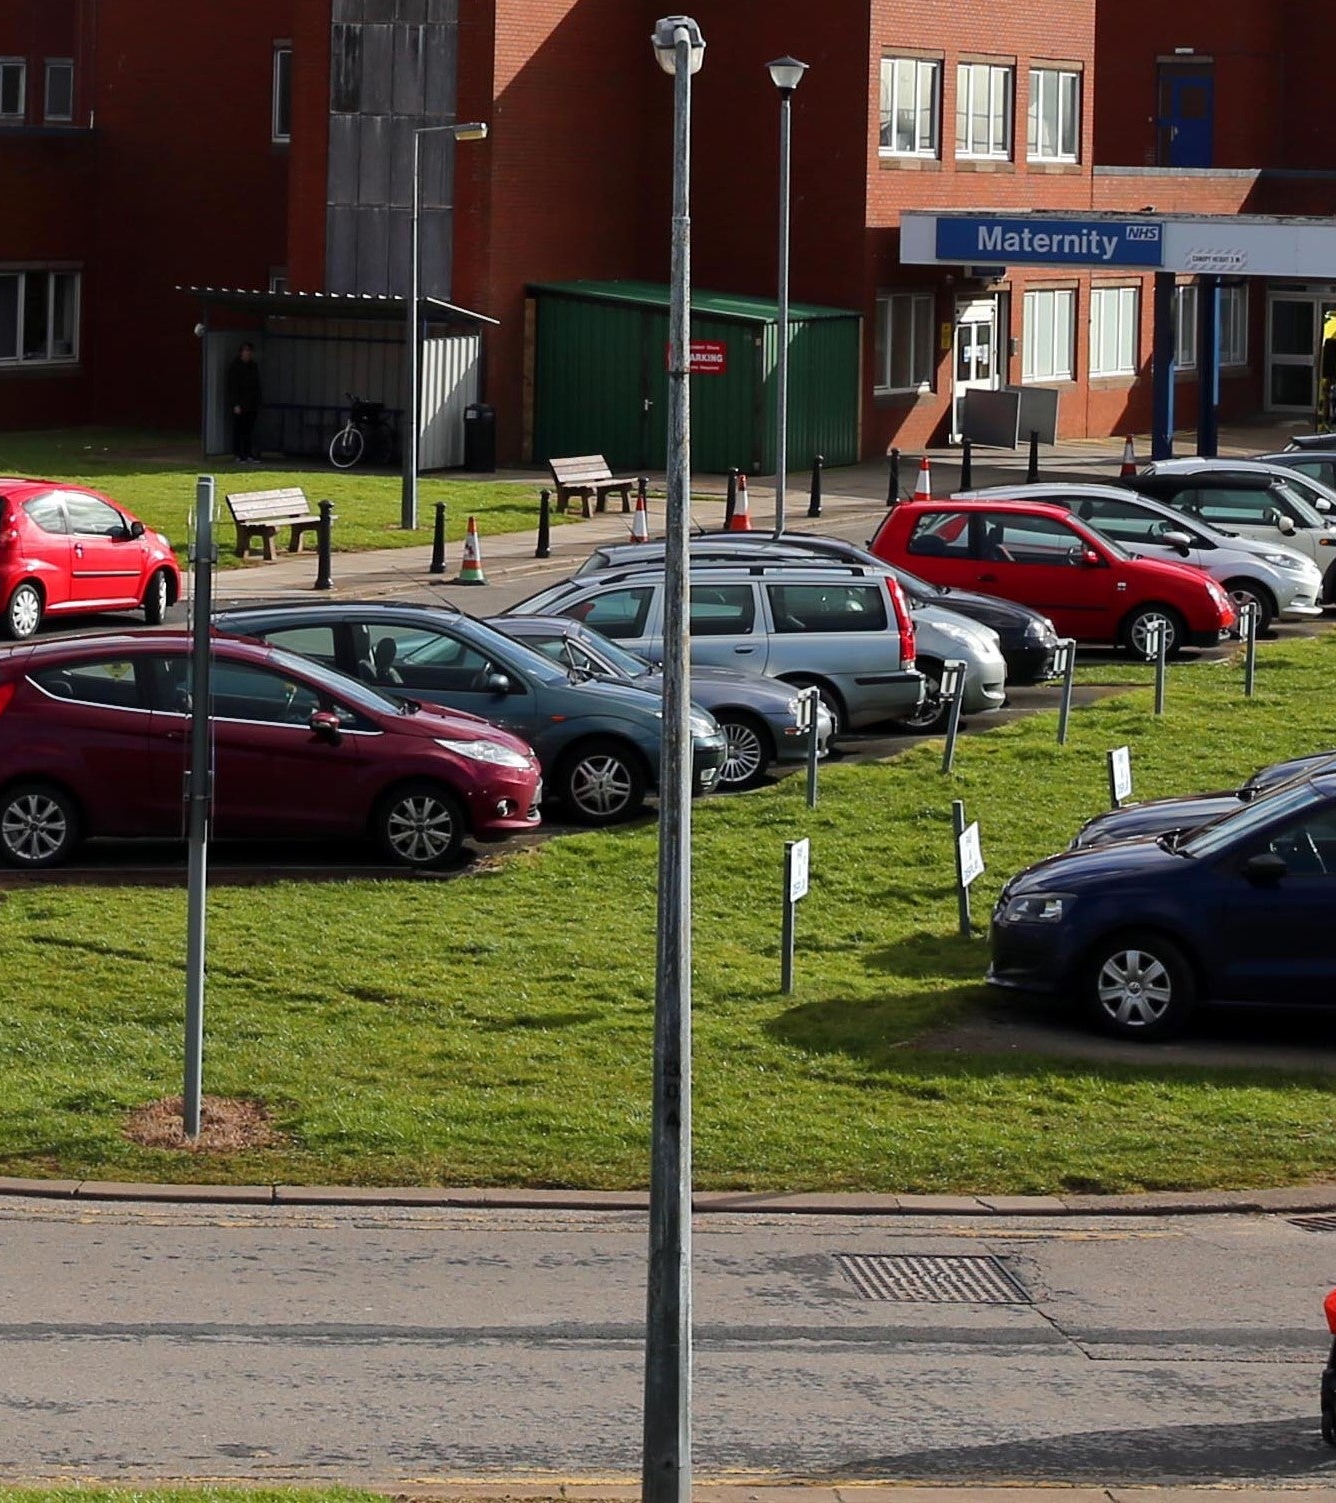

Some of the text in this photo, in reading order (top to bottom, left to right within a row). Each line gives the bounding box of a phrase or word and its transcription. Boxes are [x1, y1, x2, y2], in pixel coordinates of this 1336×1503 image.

[1127, 226, 1158, 240] NHS
[978, 226, 1118, 259] Maternity
[690, 353, 723, 363] ARKING
